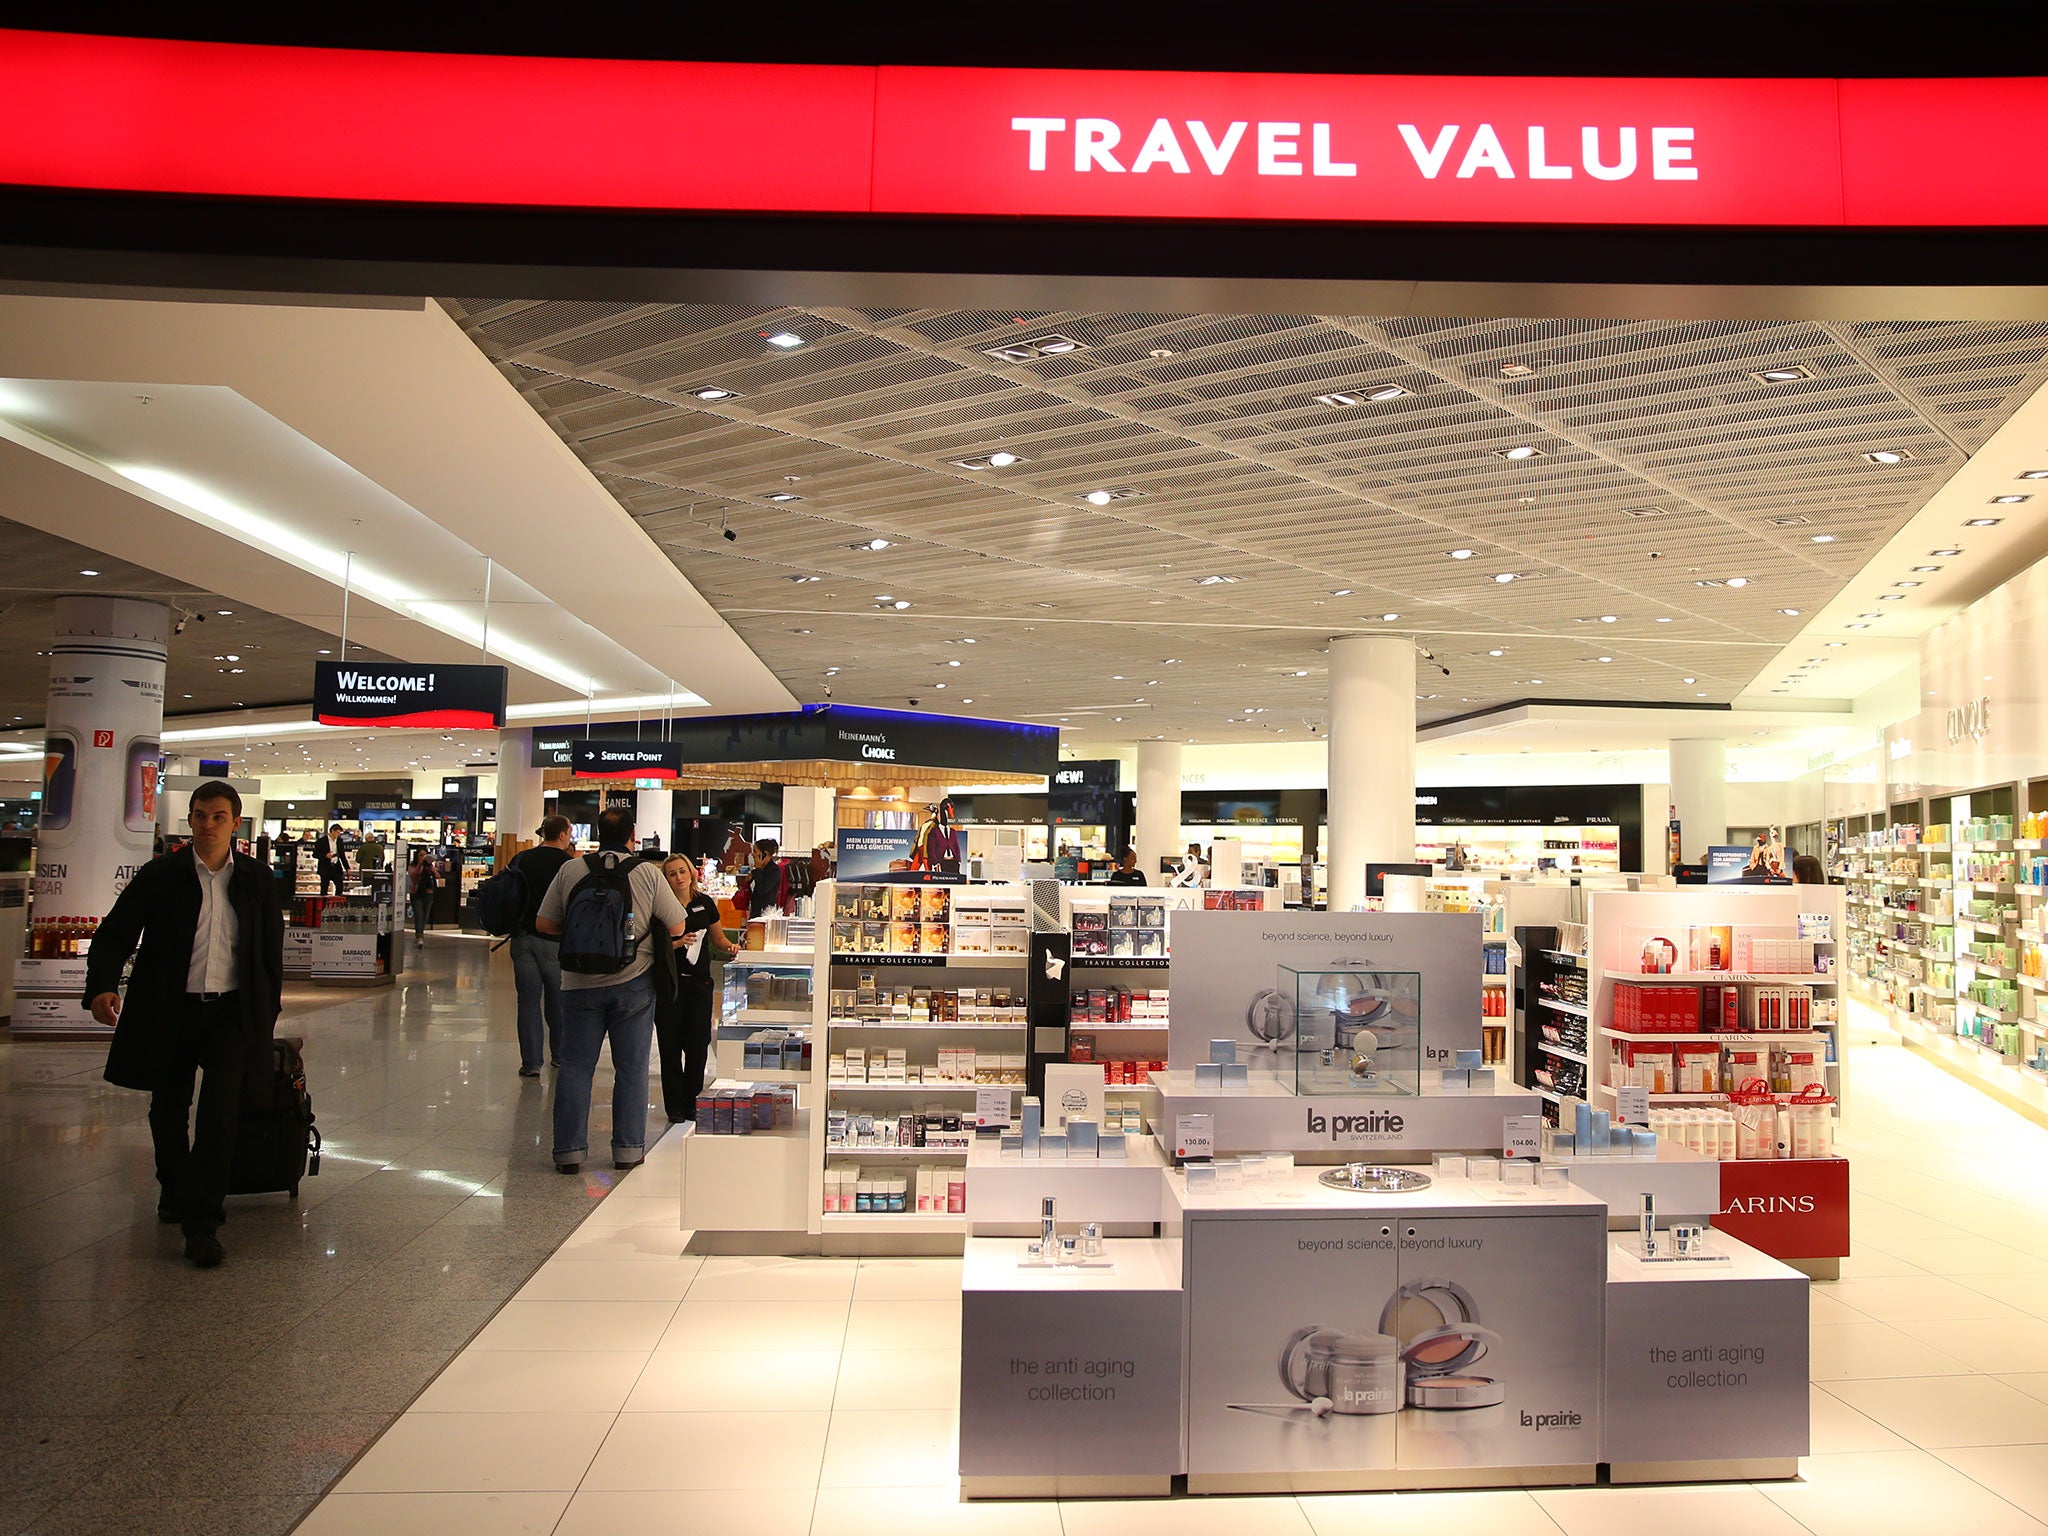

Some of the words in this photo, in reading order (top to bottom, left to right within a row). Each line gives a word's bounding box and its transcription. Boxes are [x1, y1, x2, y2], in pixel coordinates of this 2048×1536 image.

[1011, 116, 1357, 177] TRAVEL
[1397, 123, 1698, 181] VALUE
[337, 671, 434, 692] WELCOME!
[336, 693, 396, 704] WILLKOMMEN!
[838, 730, 886, 744] HEINEMANN'S
[553, 750, 572, 763] CHOIC
[601, 750, 635, 762] SERVICE
[636, 751, 662, 762] POINT
[862, 744, 896, 760] CHOICE
[1056, 770, 1084, 784] NEW!
[1182, 774, 1206, 783] NCES
[606, 798, 632, 808] HANEL
[1262, 932, 1295, 942] beyond
[1297, 932, 1333, 941] science,
[1335, 932, 1367, 943] beyond
[1368, 932, 1394, 943] luxury
[1427, 1046, 1435, 1058] la
[1308, 1108, 1326, 1133] la
[1332, 1110, 1404, 1141] prairie
[1298, 1237, 1343, 1251] beyond
[1347, 1237, 1396, 1251] science,
[1400, 1236, 1445, 1251] beyond
[1448, 1236, 1483, 1251] luxury
[1650, 1347, 1677, 1364] the
[1682, 1346, 1712, 1362] anti
[1718, 1345, 1765, 1364] aging
[1010, 1357, 1039, 1375] the
[1045, 1357, 1078, 1374] anti
[1084, 1358, 1135, 1378] aging
[1667, 1371, 1748, 1388] collection
[1028, 1384, 1116, 1400] collection
[1344, 1386, 1353, 1400] la
[1355, 1387, 1393, 1405] prairie
[1520, 1410, 1532, 1426] la
[1536, 1411, 1581, 1431] prairie
